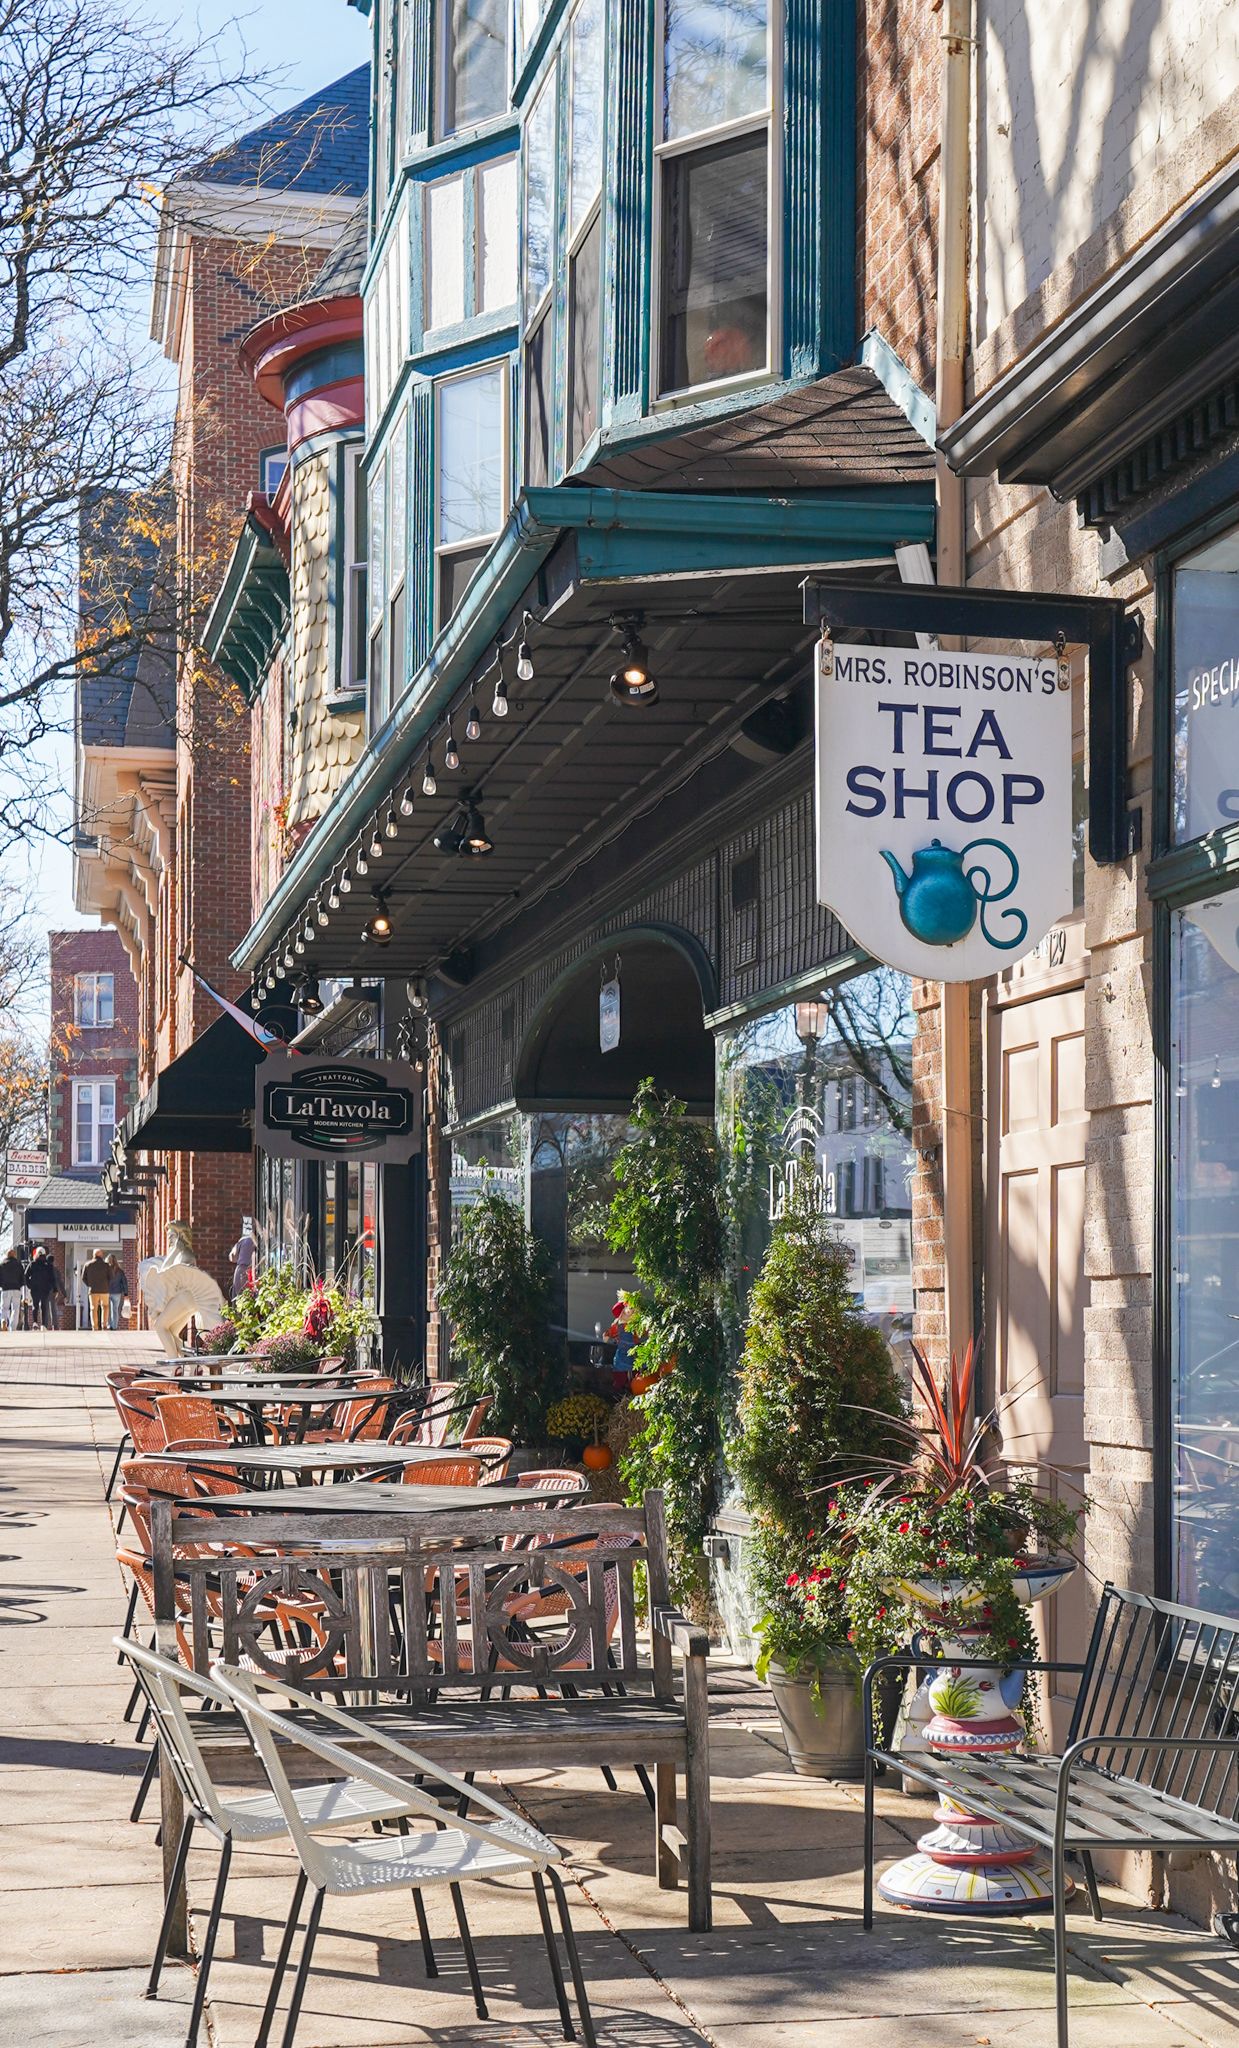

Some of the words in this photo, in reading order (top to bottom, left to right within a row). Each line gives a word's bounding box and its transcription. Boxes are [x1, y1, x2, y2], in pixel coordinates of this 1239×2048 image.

[834, 656, 892, 685] MRS.
[903, 660, 1056, 695] ROBINSON'S
[877, 701, 1014, 760] TEA
[845, 765, 1045, 825] SHOP
[318, 1074, 361, 1084] TRATTORIA
[8, 1163, 46, 1174] BARBER
[15, 1176, 40, 1186] Shop
